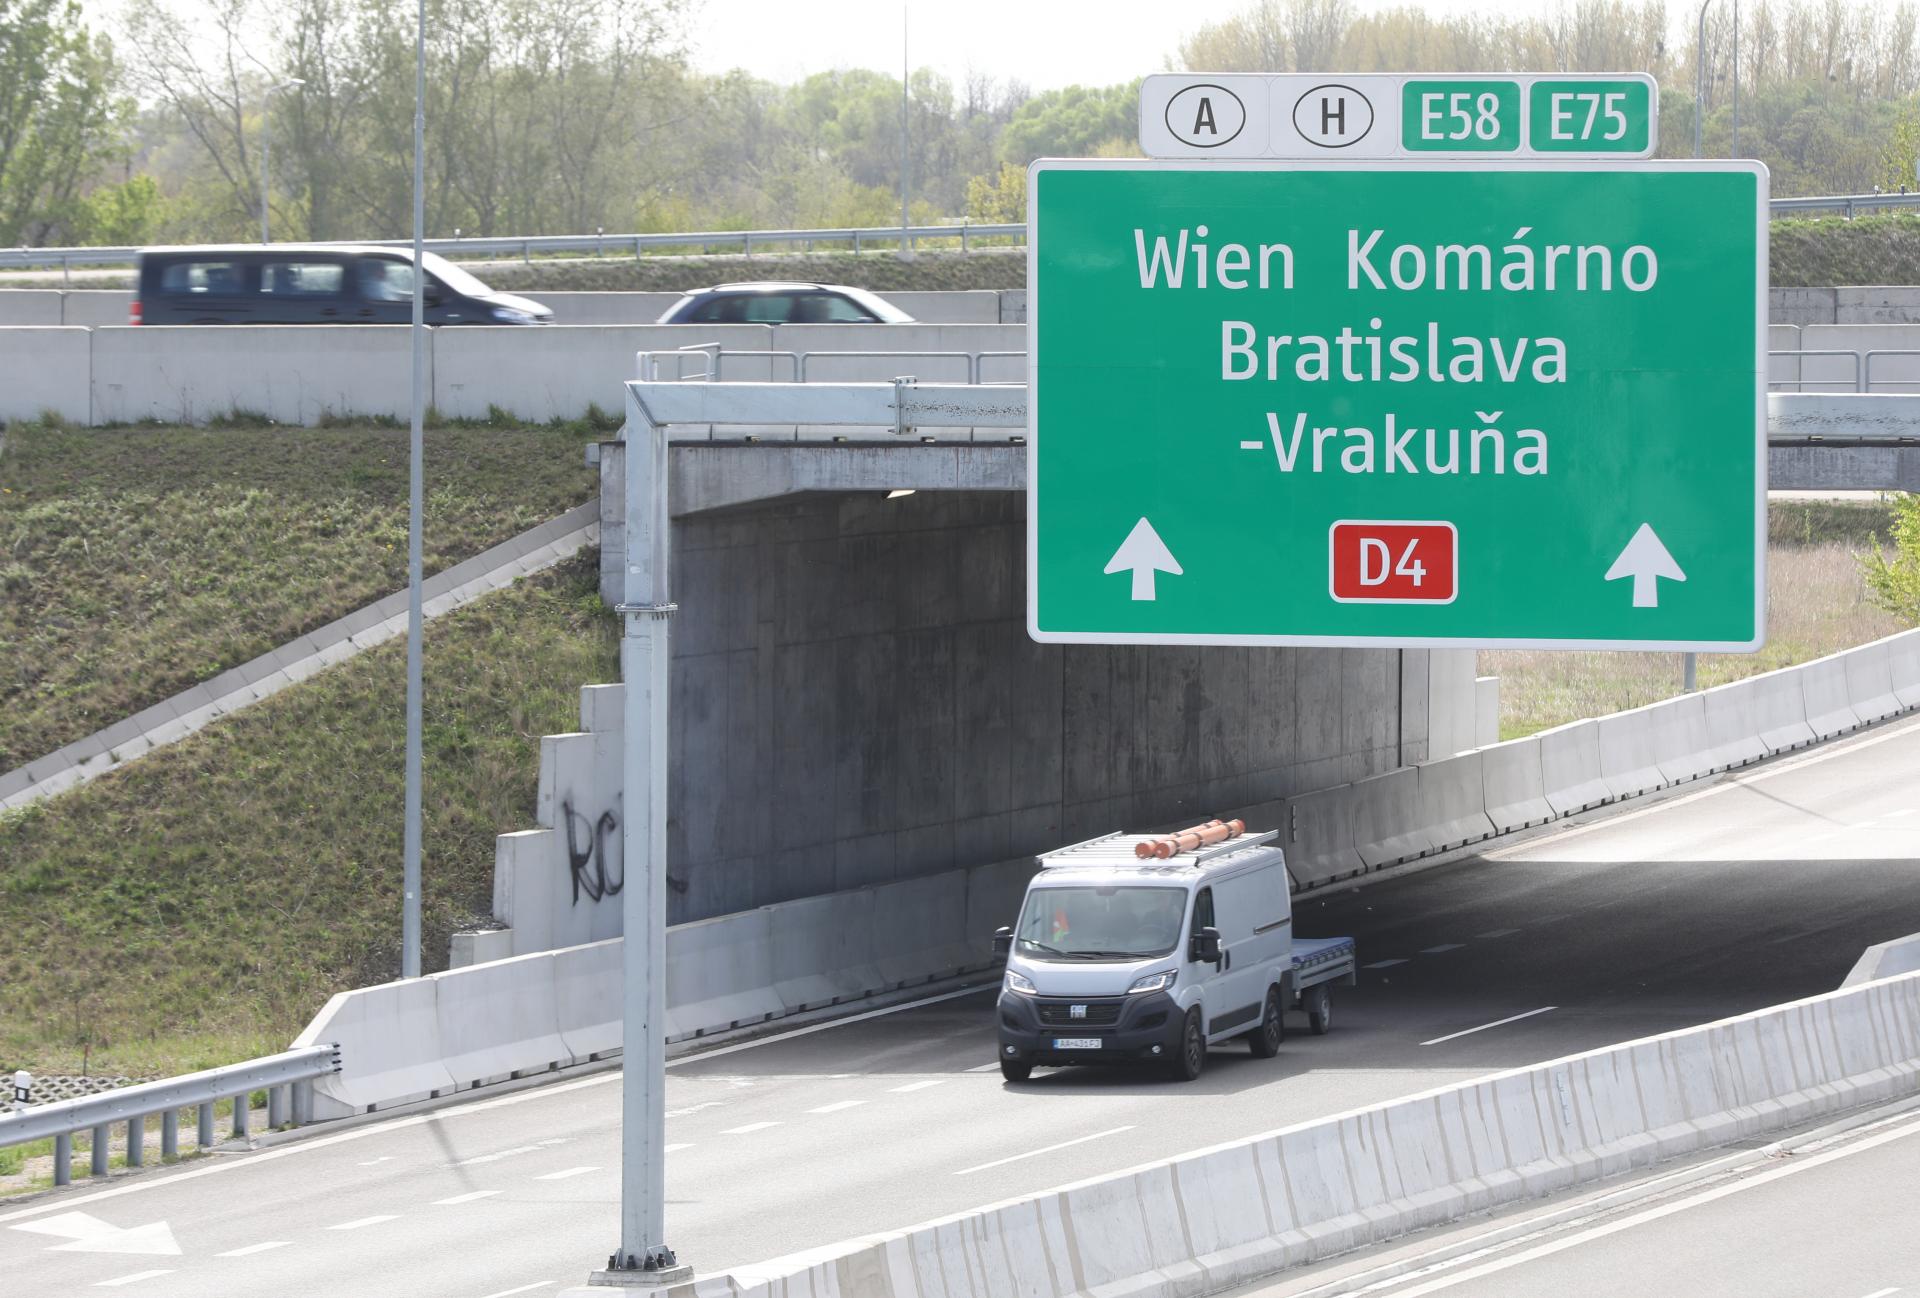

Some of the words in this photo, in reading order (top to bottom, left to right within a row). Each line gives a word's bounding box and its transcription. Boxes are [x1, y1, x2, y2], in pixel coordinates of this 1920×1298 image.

[1193, 97, 1218, 135] A
[1321, 97, 1345, 135] H
[1421, 92, 1501, 141] E58
[1551, 92, 1627, 141] E75
[1134, 225, 1294, 290] Wien
[1348, 226, 1658, 292] Komárno
[1222, 317, 1567, 384] Bratislava
[1240, 411, 1548, 475] -Vrakuňa
[1359, 537, 1427, 587] D4
